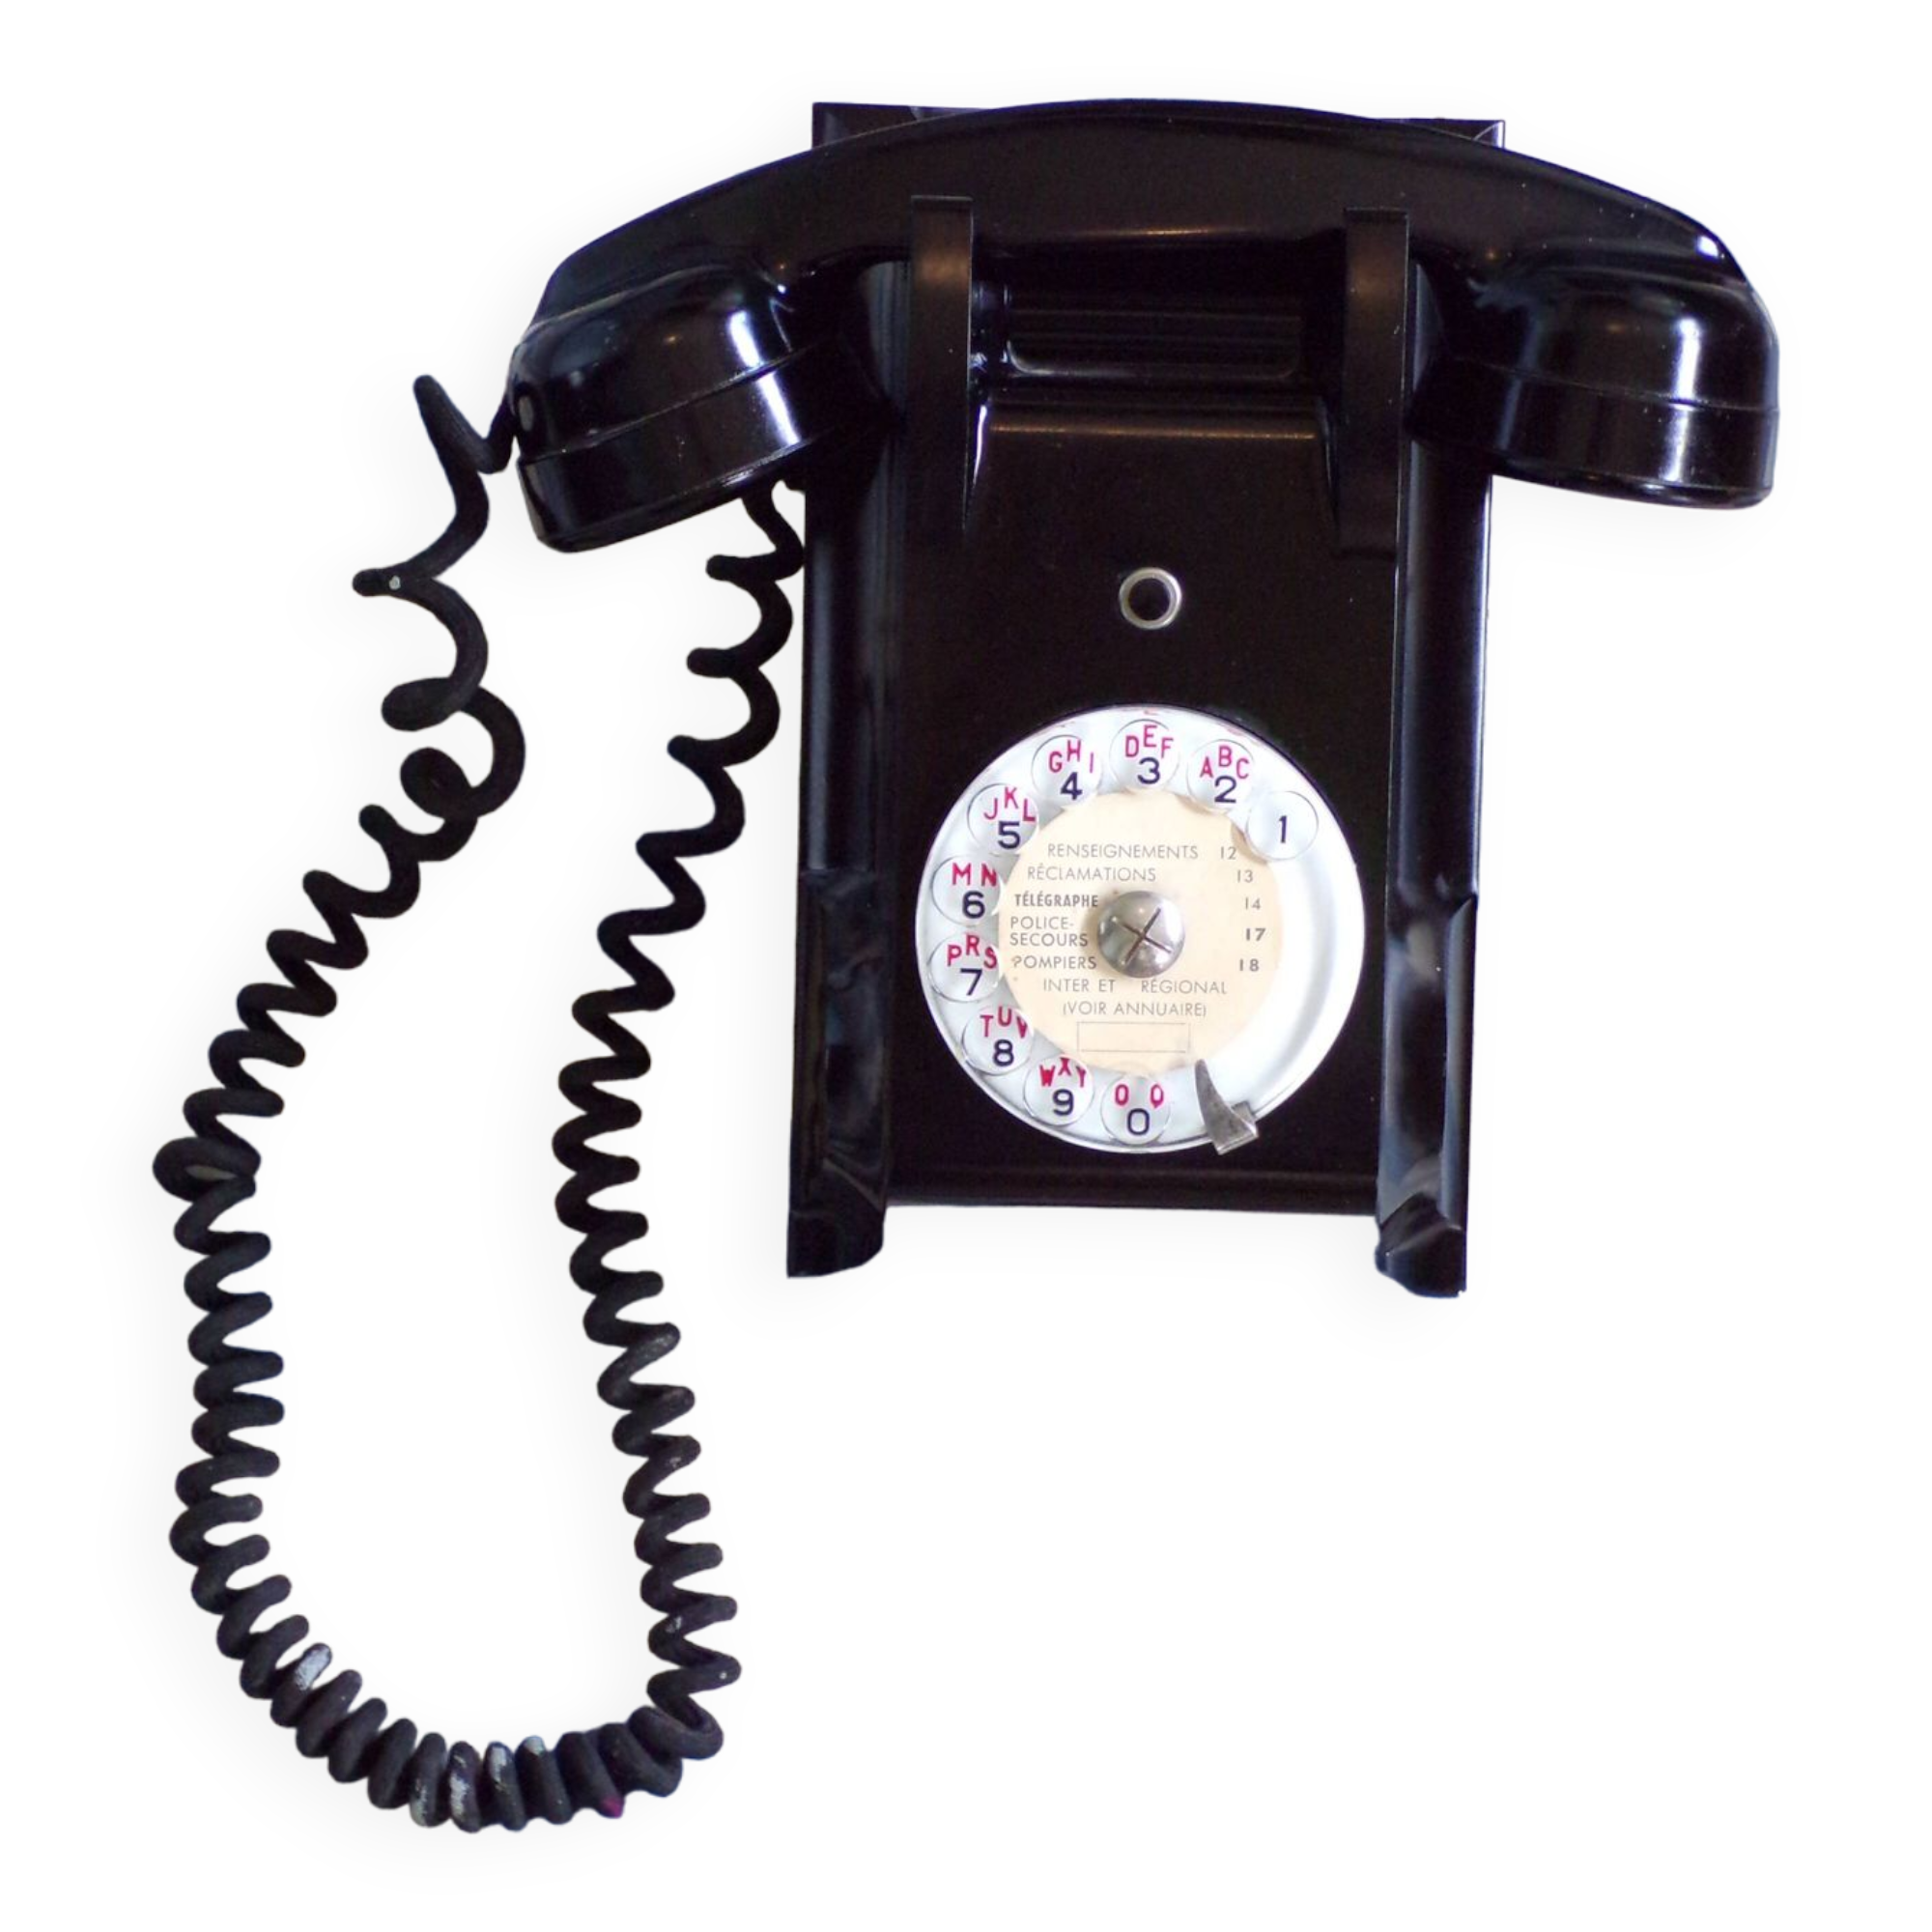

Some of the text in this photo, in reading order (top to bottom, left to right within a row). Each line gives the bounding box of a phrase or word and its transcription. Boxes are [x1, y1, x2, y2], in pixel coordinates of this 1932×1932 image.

[1125, 724, 1174, 758] DEF
[1048, 739, 1094, 773] GHI
[1137, 756, 1161, 784] 3
[1200, 745, 1250, 780] ABC
[1060, 772, 1083, 801] 4
[1213, 775, 1237, 803] 2
[983, 786, 1037, 823] JKL
[998, 820, 1021, 849] 5
[1278, 815, 1288, 844] 1
[1047, 843, 1237, 861] RENSEIGNEMENTS 12
[1027, 863, 1254, 883] RÉCLAMATIONS 13
[961, 891, 985, 919] 6
[1014, 891, 1262, 910] TÉLÉGRAPHE 14
[1010, 915, 1074, 930] POLICE-
[947, 931, 998, 969] PRS
[1009, 927, 1266, 948] SECOURS 17
[1239, 958, 1260, 972] 18
[960, 968, 983, 996] 7
[1043, 977, 1228, 994] INTER ET RÉGIONAL
[1063, 1000, 1208, 1017] (VOIR ANNUAIRE)
[992, 1038, 1014, 1067] 8
[1052, 1089, 1074, 1116] 9
[1126, 1108, 1151, 1136] 0
